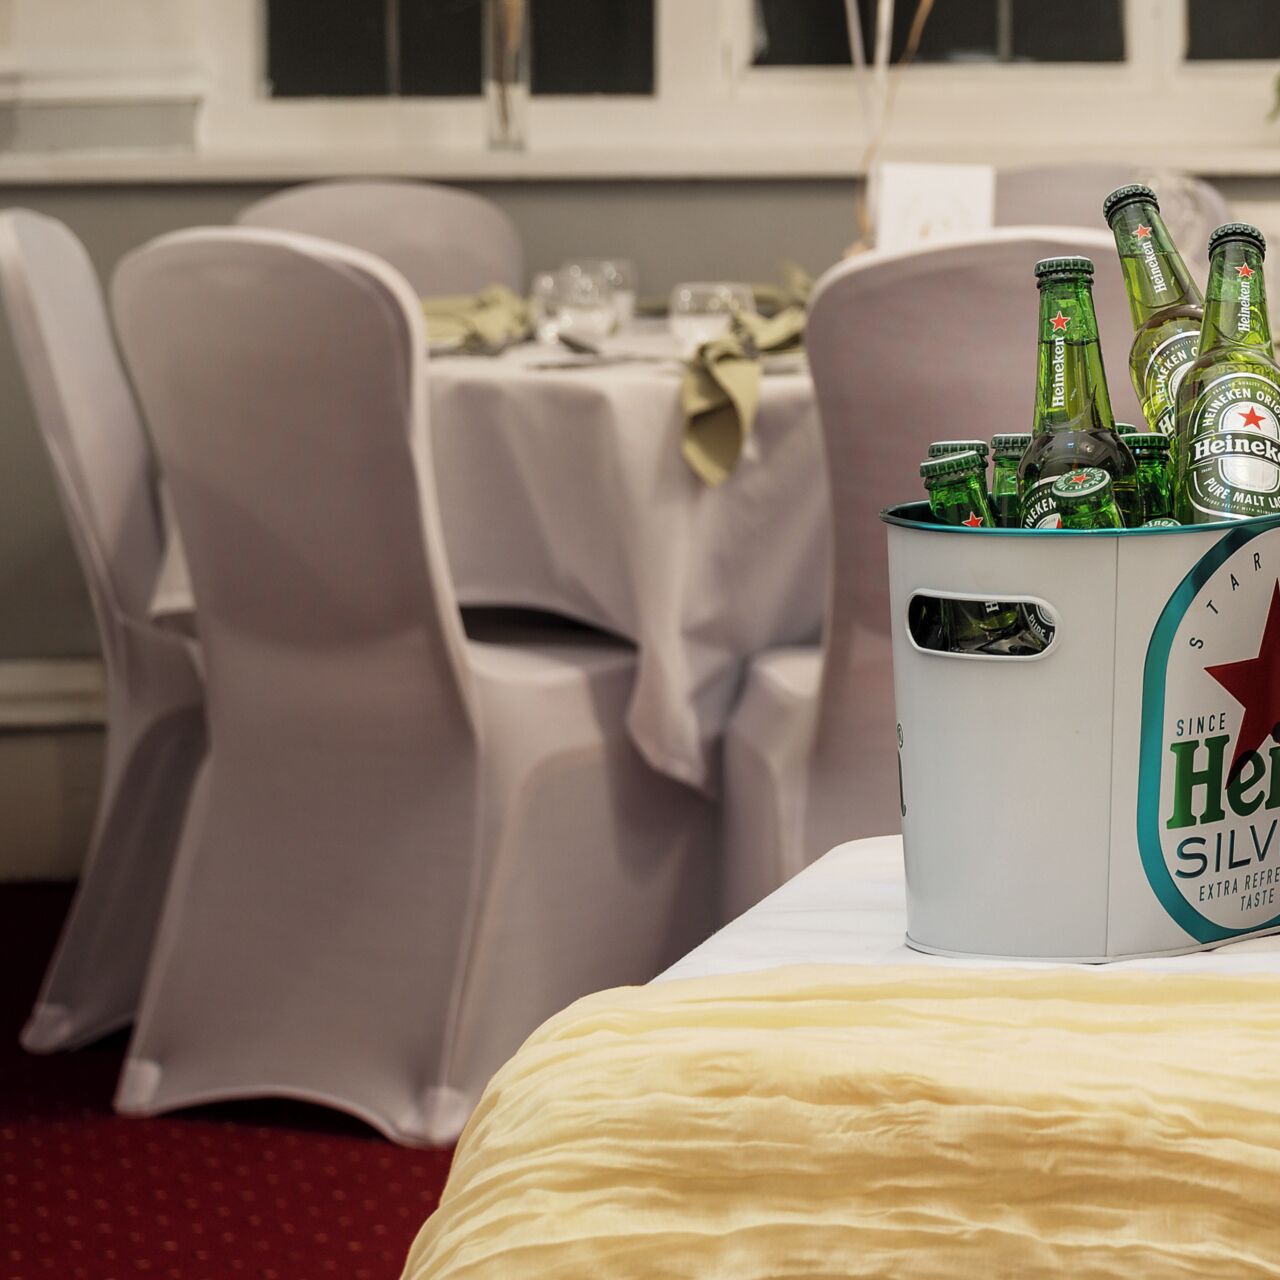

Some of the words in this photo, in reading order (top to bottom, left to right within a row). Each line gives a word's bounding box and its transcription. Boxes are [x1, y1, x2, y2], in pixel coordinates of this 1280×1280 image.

[1142, 240, 1168, 294] Heineken
[1237, 281, 1251, 332] Heineken
[1051, 336, 1065, 408] Heineken
[1202, 388, 1251, 427] HEINEKEN
[1203, 477, 1231, 499] PURE
[1232, 491, 1265, 507] MALT
[1023, 497, 1057, 529] INEKEN
[1189, 551, 1262, 649] STAR
[1176, 712, 1226, 737] SINCE
[1199, 879, 1239, 902] EXTRA
[1240, 887, 1276, 911] TASTE
